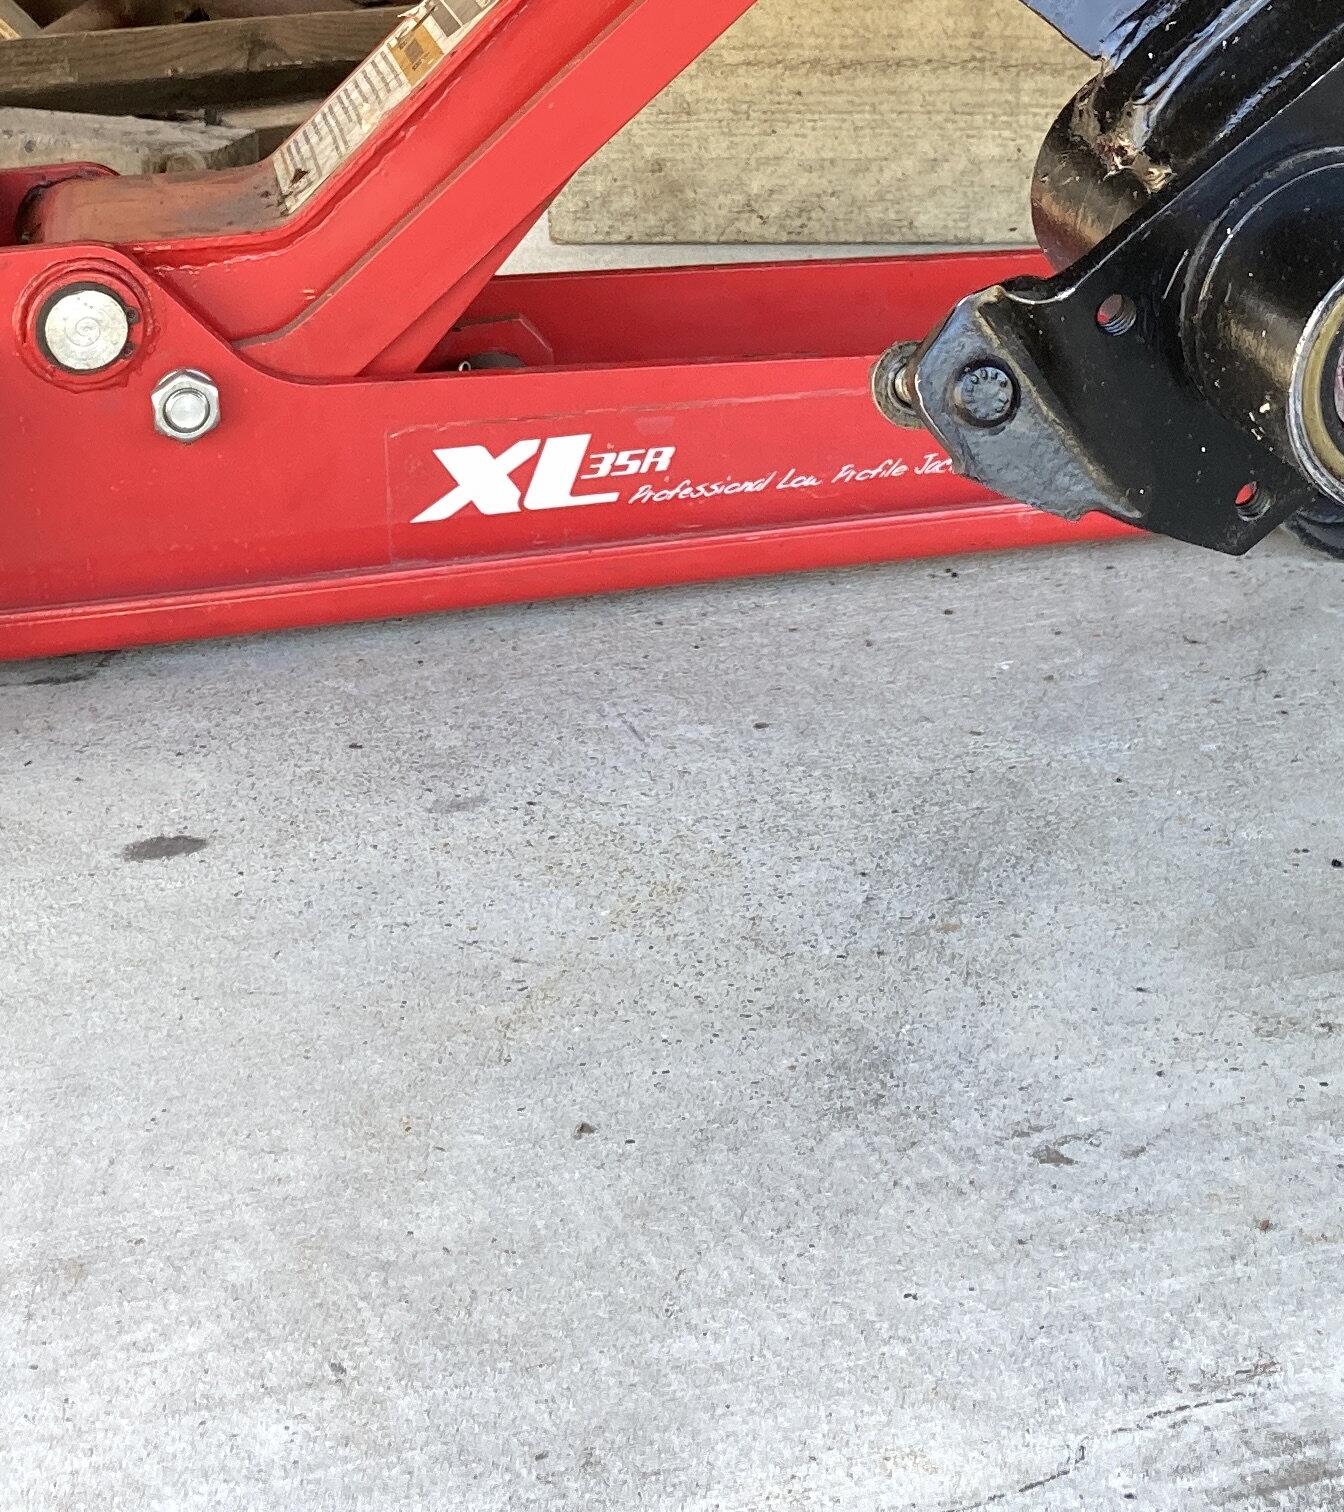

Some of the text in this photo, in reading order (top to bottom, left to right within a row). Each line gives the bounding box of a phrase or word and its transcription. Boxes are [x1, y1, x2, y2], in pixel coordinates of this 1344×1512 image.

[409, 433, 620, 523] XL
[628, 452, 955, 504] Professional Low Profile Jac
